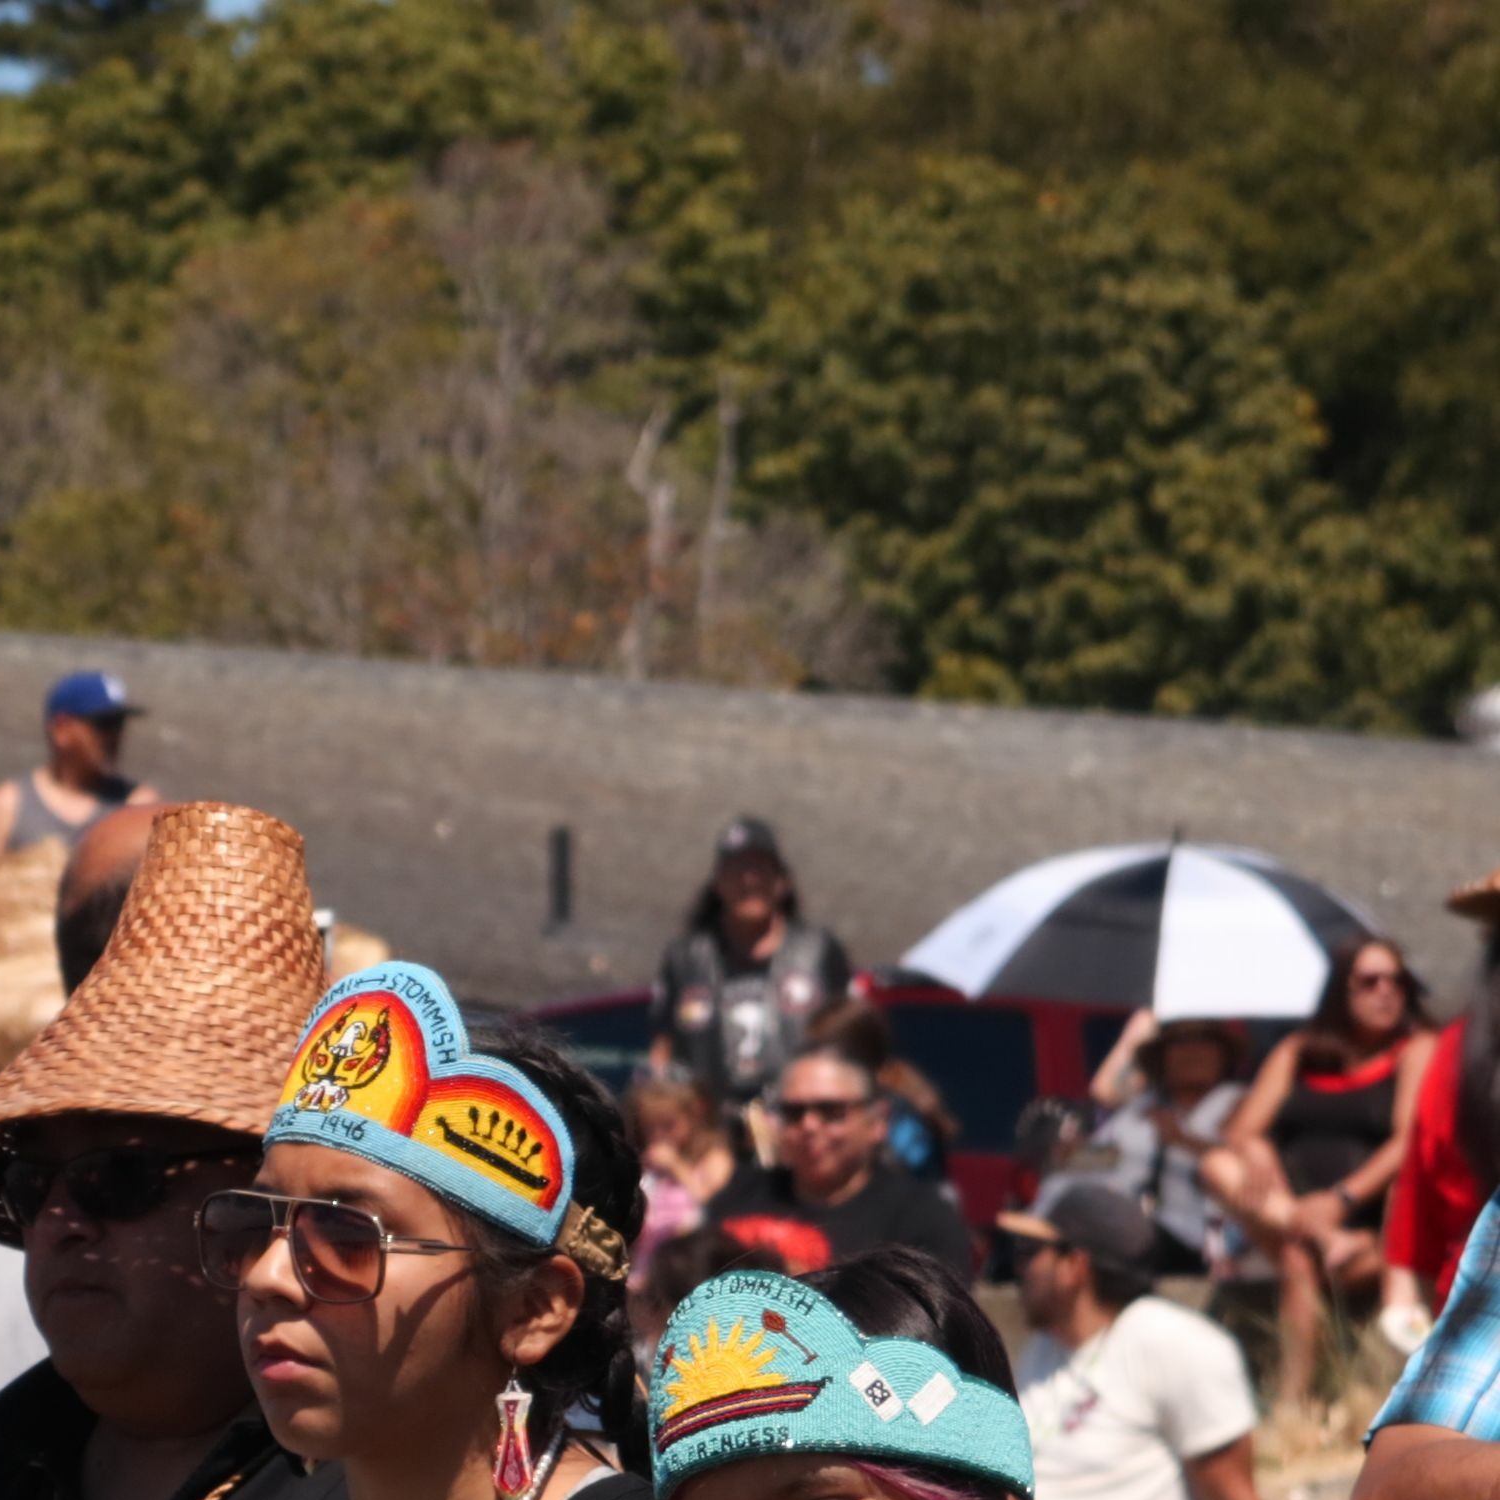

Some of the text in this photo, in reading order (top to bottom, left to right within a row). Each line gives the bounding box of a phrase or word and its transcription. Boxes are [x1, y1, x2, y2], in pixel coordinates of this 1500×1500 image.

[386, 972, 457, 1065] STOMMISH
[320, 1115, 368, 1141] 1946
[705, 1278, 816, 1316] STOMMISH
